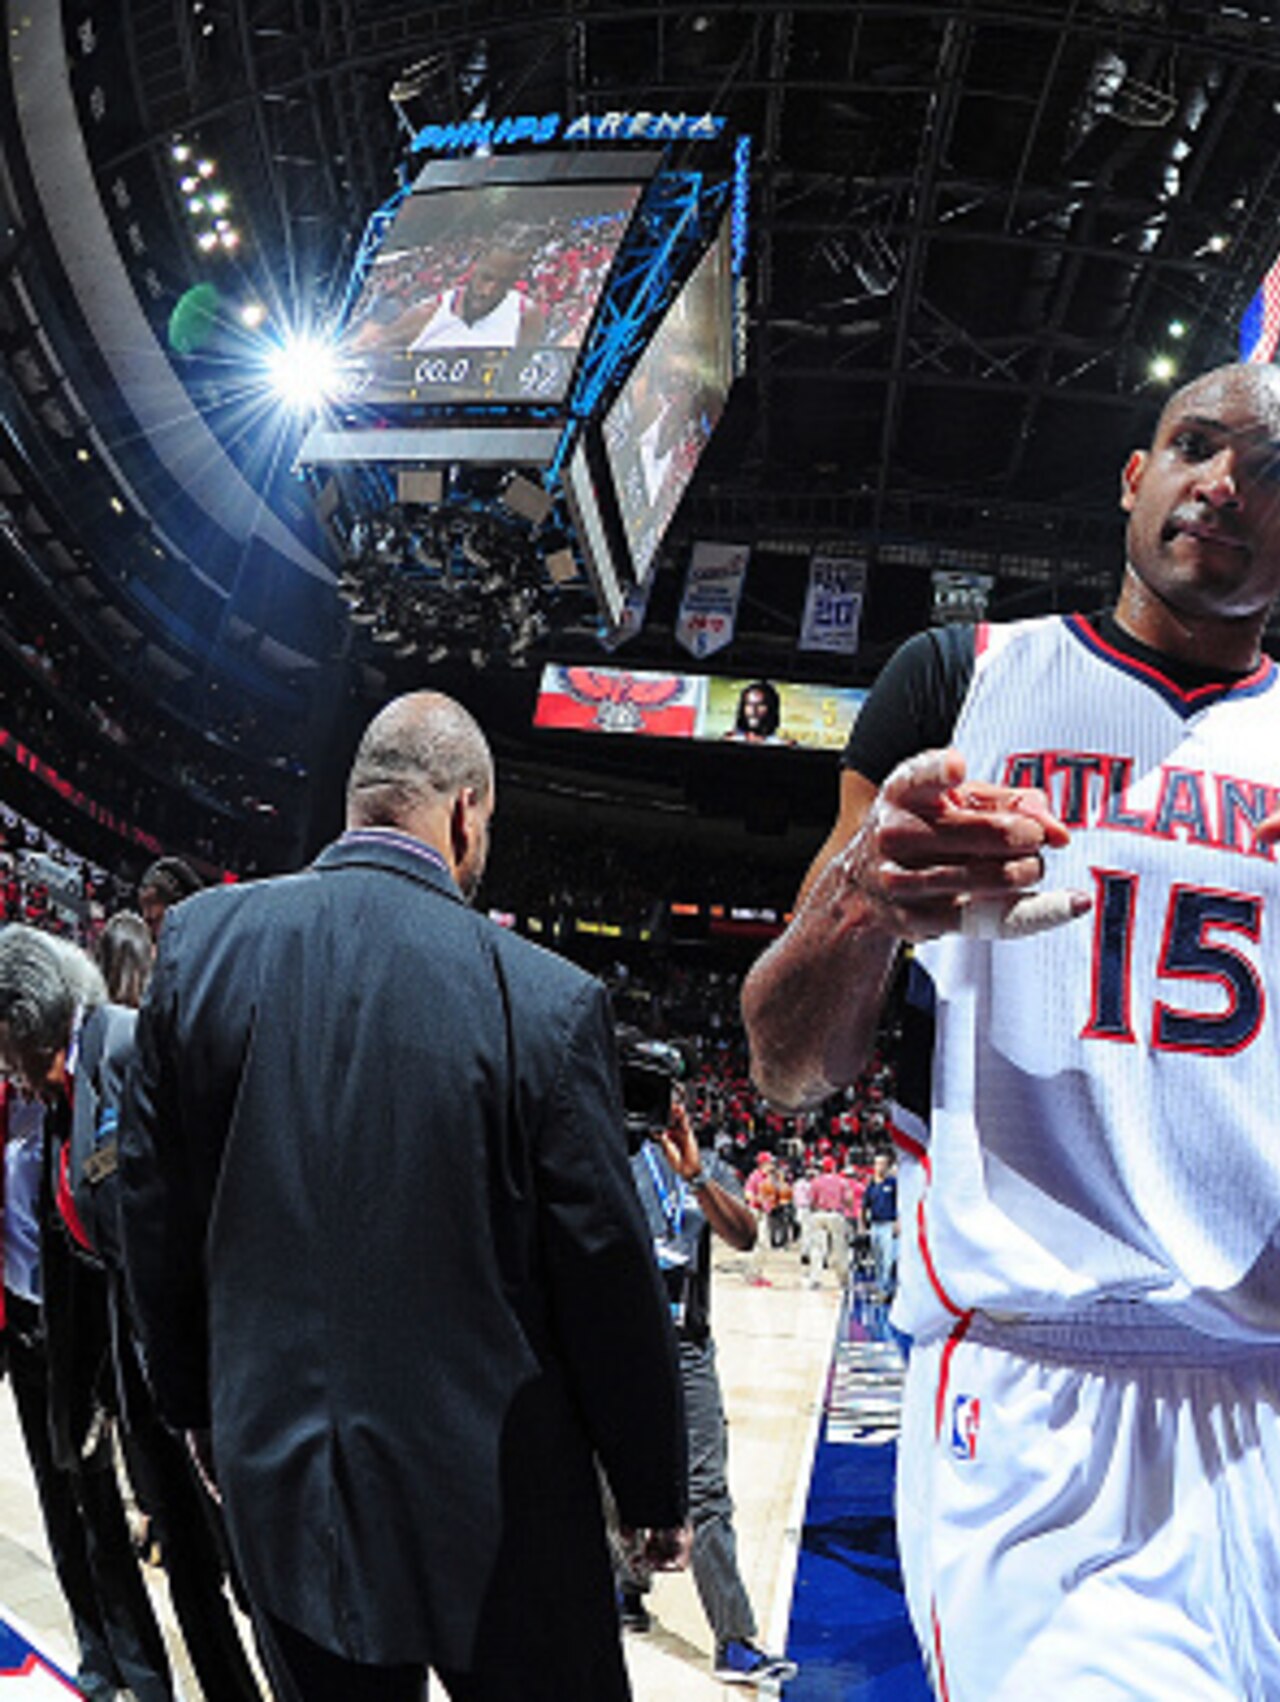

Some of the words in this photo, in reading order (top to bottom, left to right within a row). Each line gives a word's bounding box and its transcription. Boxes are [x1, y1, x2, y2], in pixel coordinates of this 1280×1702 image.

[411, 113, 560, 153] PHILIPS
[563, 111, 726, 140] ARENA
[1079, 866, 1267, 1058] 15
